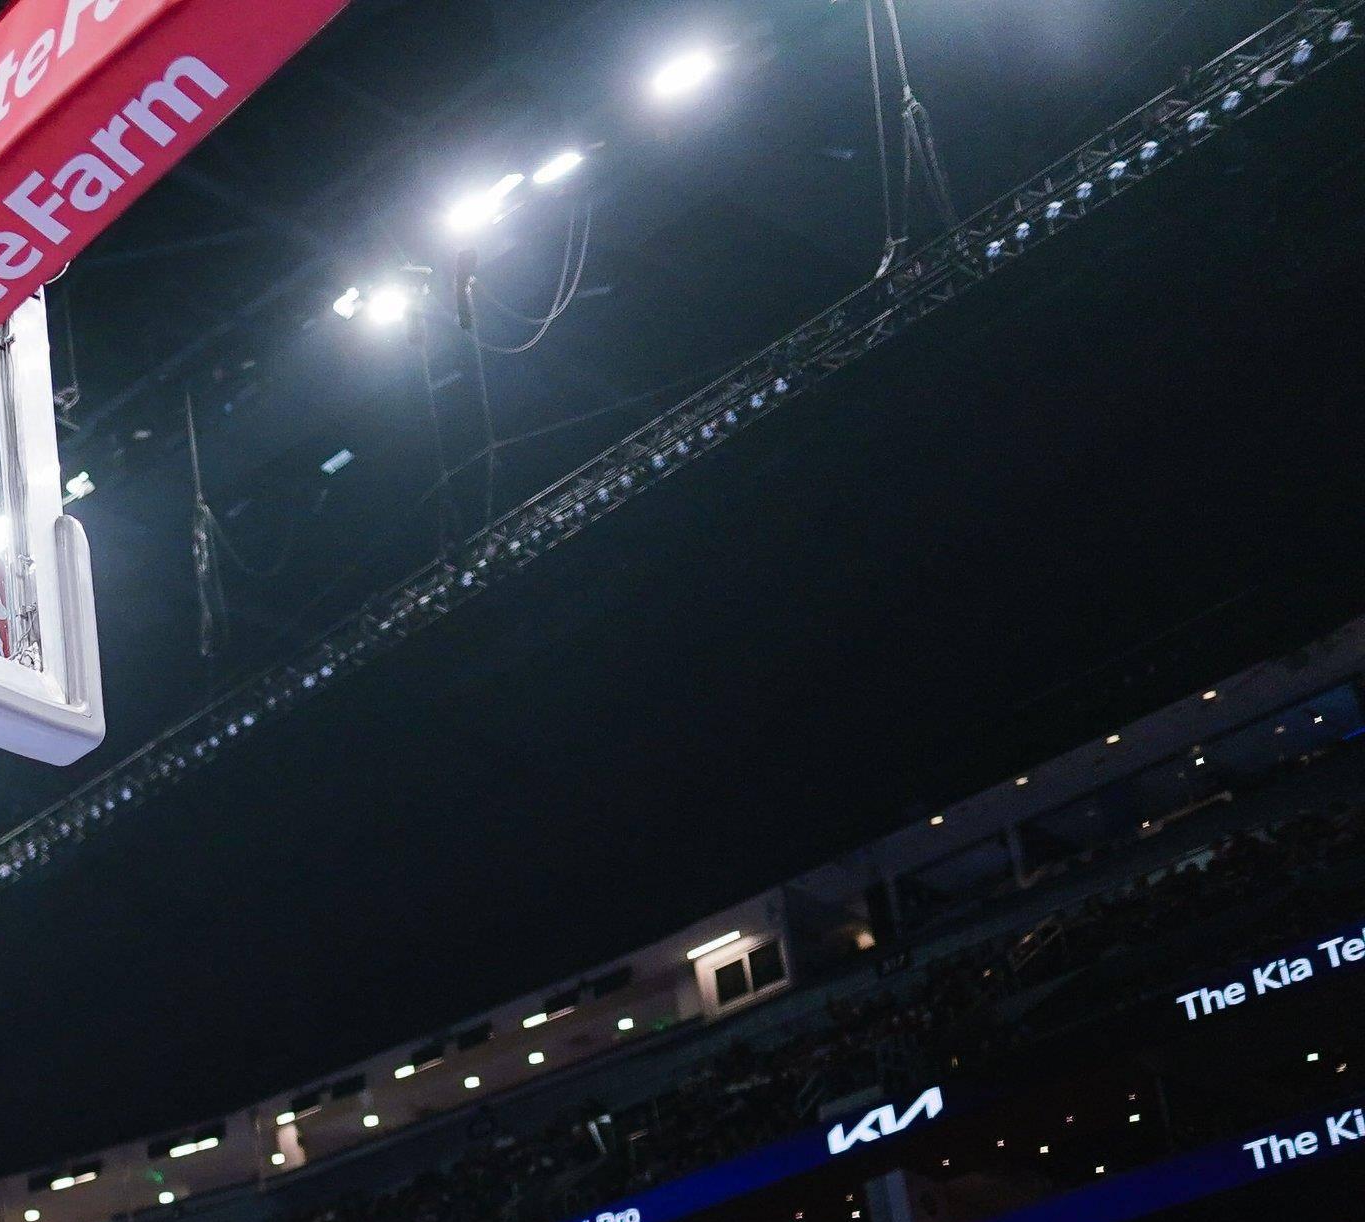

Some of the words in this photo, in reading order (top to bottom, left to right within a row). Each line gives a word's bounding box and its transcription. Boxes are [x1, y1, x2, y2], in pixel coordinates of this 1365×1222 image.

[1175, 982, 1246, 1021] The
[1252, 958, 1313, 995] Kia
[1242, 1131, 1319, 1170] The
[1326, 1108, 1365, 1146] Ki
